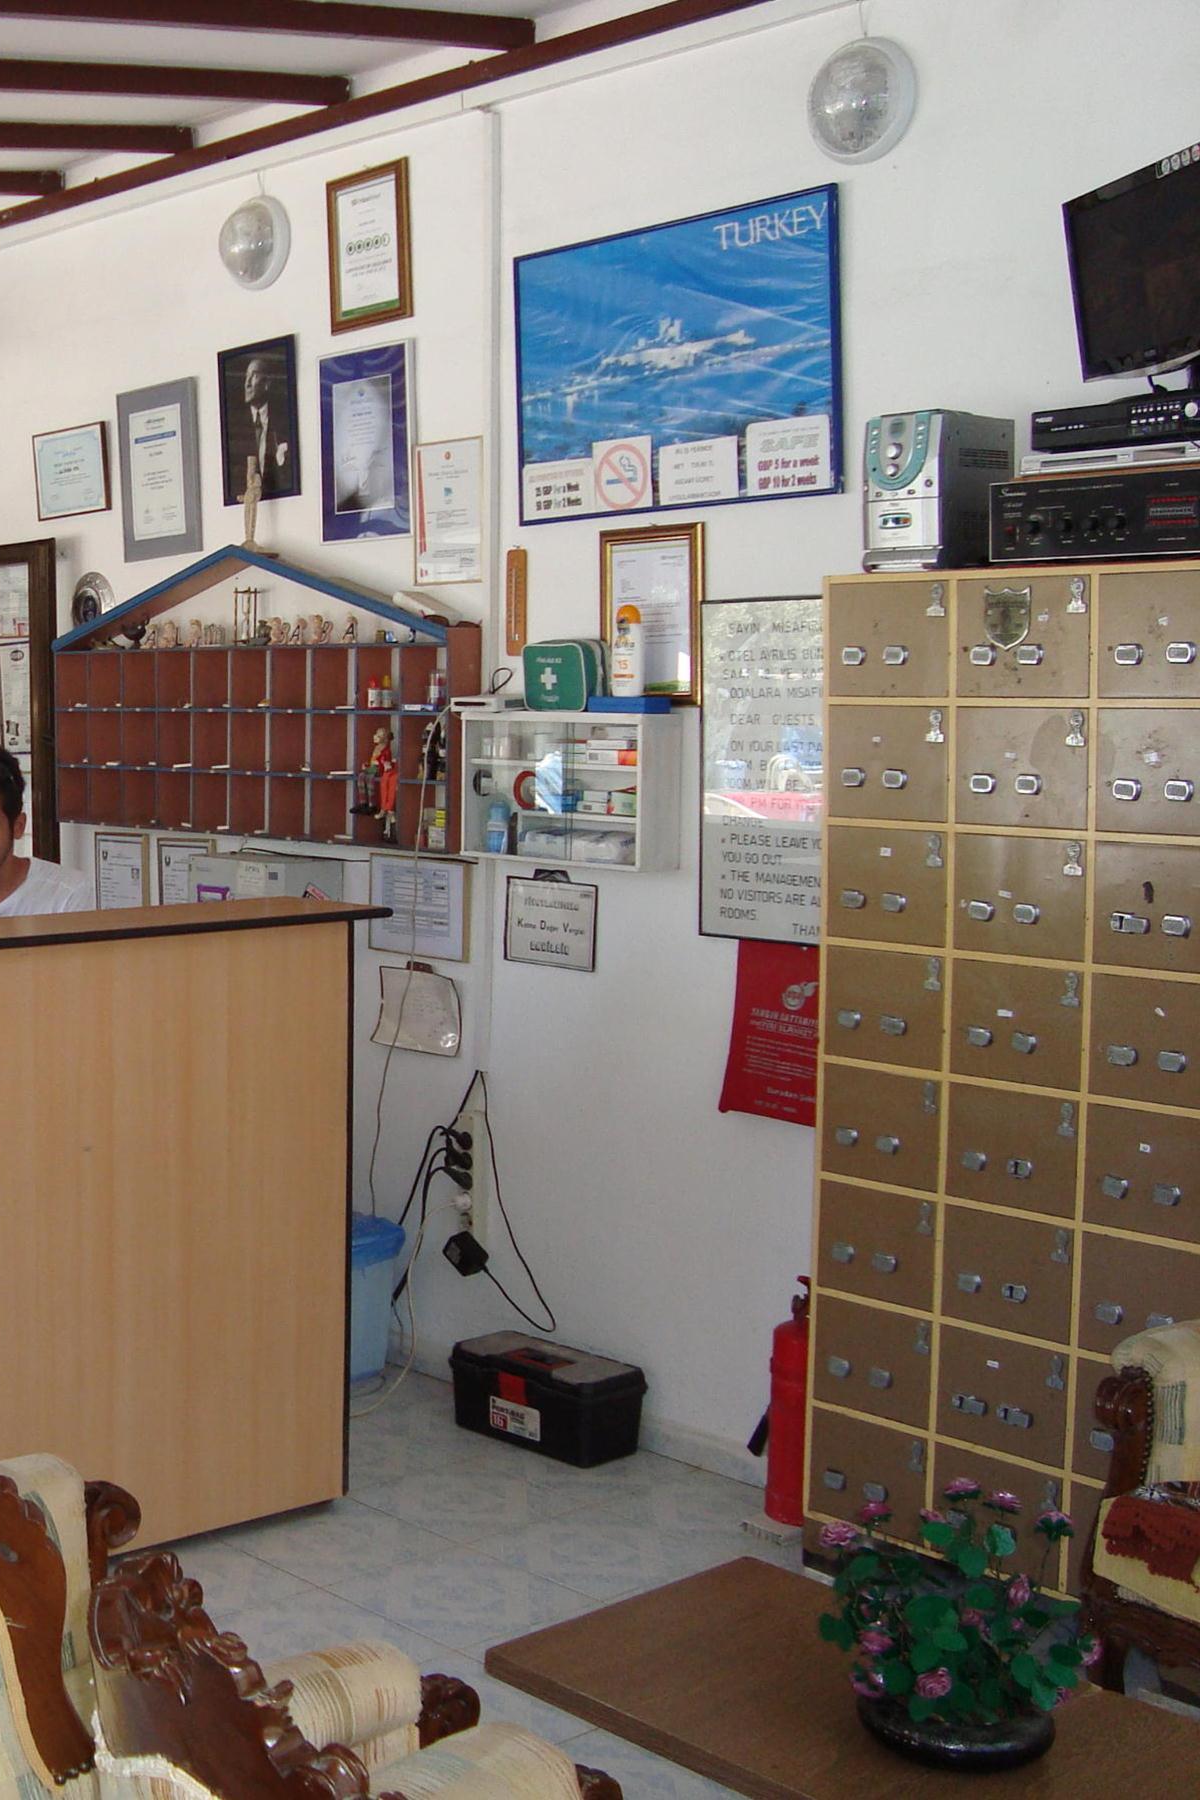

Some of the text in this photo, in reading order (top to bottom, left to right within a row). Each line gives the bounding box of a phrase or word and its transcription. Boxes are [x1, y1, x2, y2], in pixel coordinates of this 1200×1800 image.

[712, 200, 828, 251] TURKEY
[760, 433, 820, 453] SAFE
[781, 457, 792, 469] for
[729, 740, 744, 752] ON
[730, 833, 772, 847] PLEASE
[775, 836, 809, 850] LEAVE
[721, 851, 741, 863] YOU
[744, 852, 760, 865] GO
[730, 869, 750, 882] THE
[720, 887, 734, 900] NO
[737, 889, 783, 904] VISITORS
[784, 891, 808, 906] ARE
